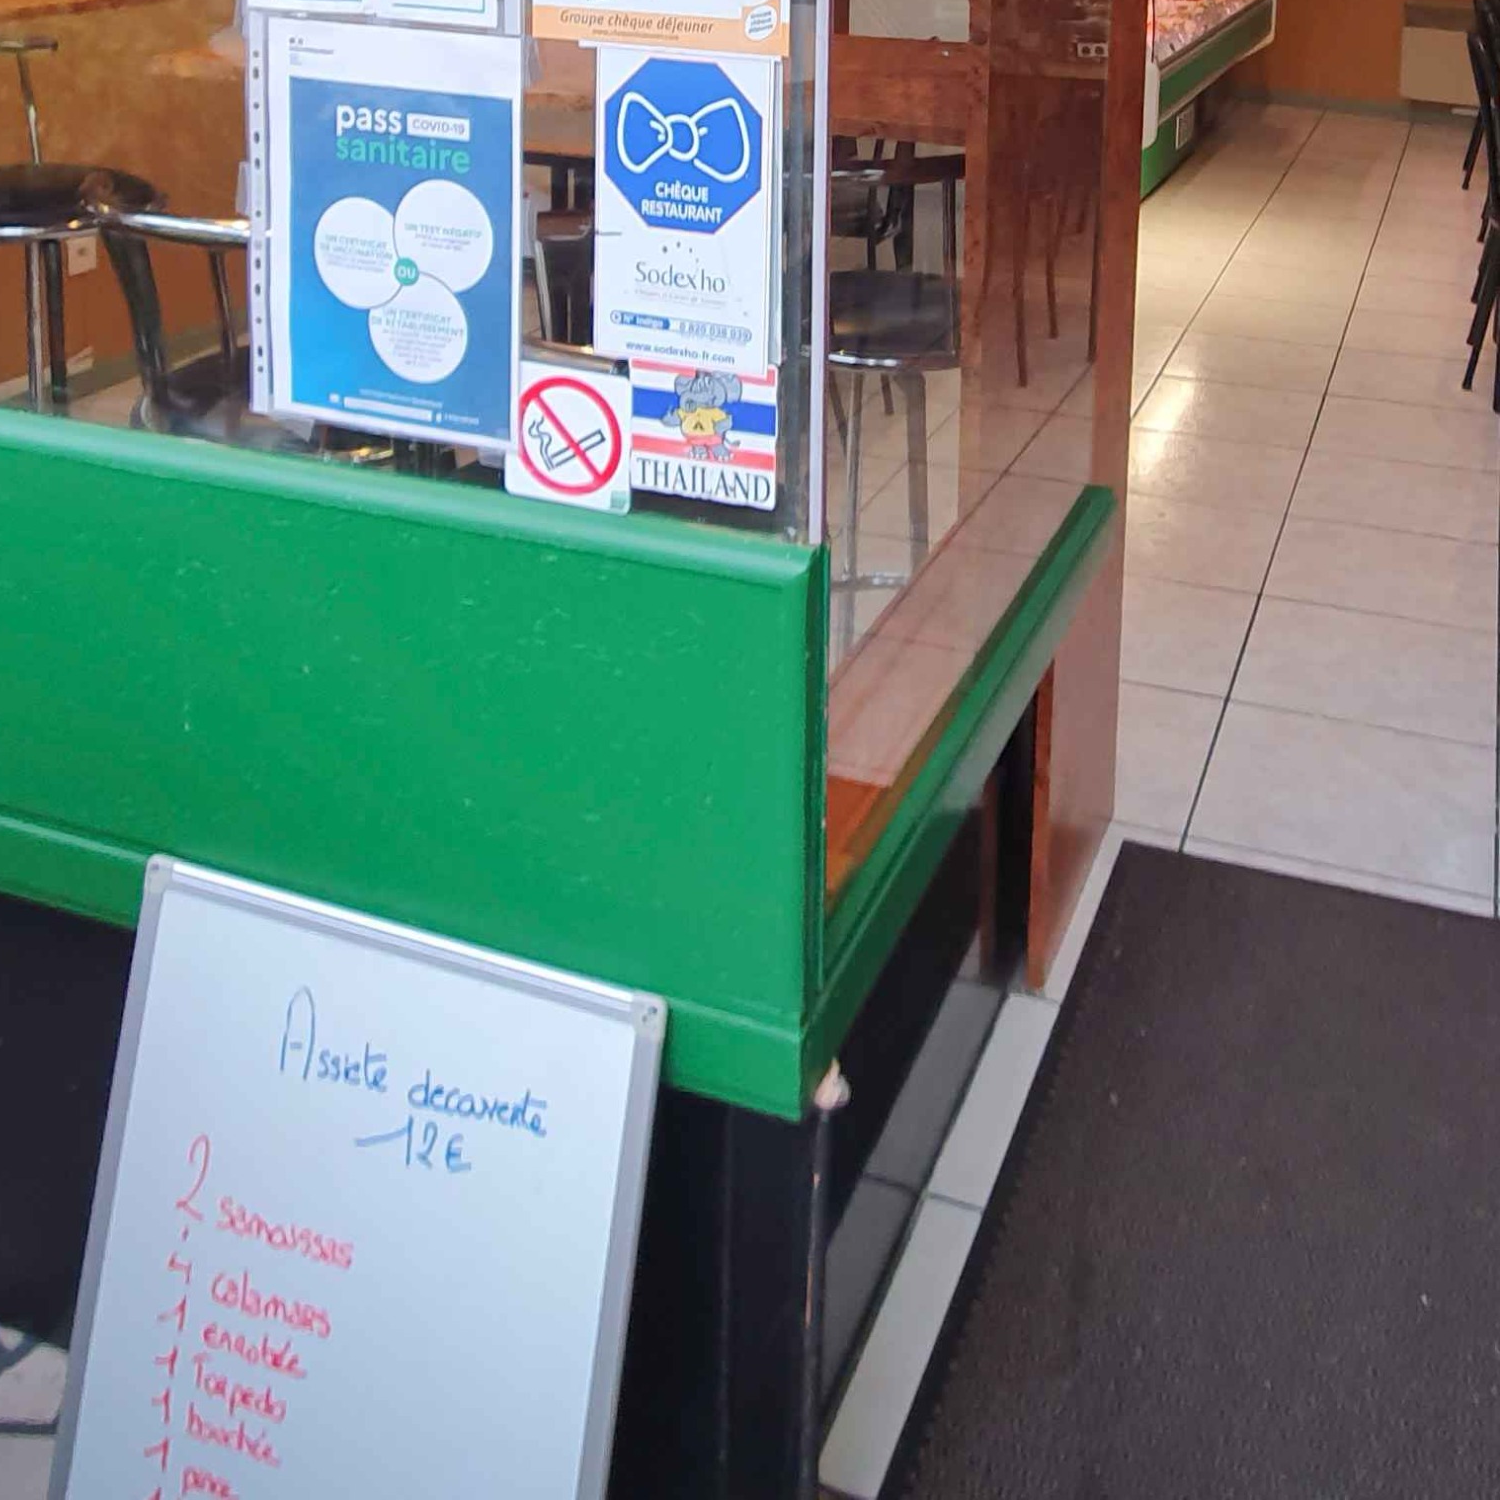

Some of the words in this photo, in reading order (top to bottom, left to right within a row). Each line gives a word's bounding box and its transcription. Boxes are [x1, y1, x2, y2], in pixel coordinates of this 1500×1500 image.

[559, 9, 604, 27] Groupe
[608, 12, 653, 32] chèque
[336, 104, 402, 137] pass
[411, 118, 466, 135] COVID-19
[336, 134, 471, 174] sanitaire
[655, 180, 709, 203] CHÈQUE
[641, 200, 723, 224] RESTAURANT
[636, 457, 771, 503] THAILAND
[175, 1133, 210, 1221] 2
